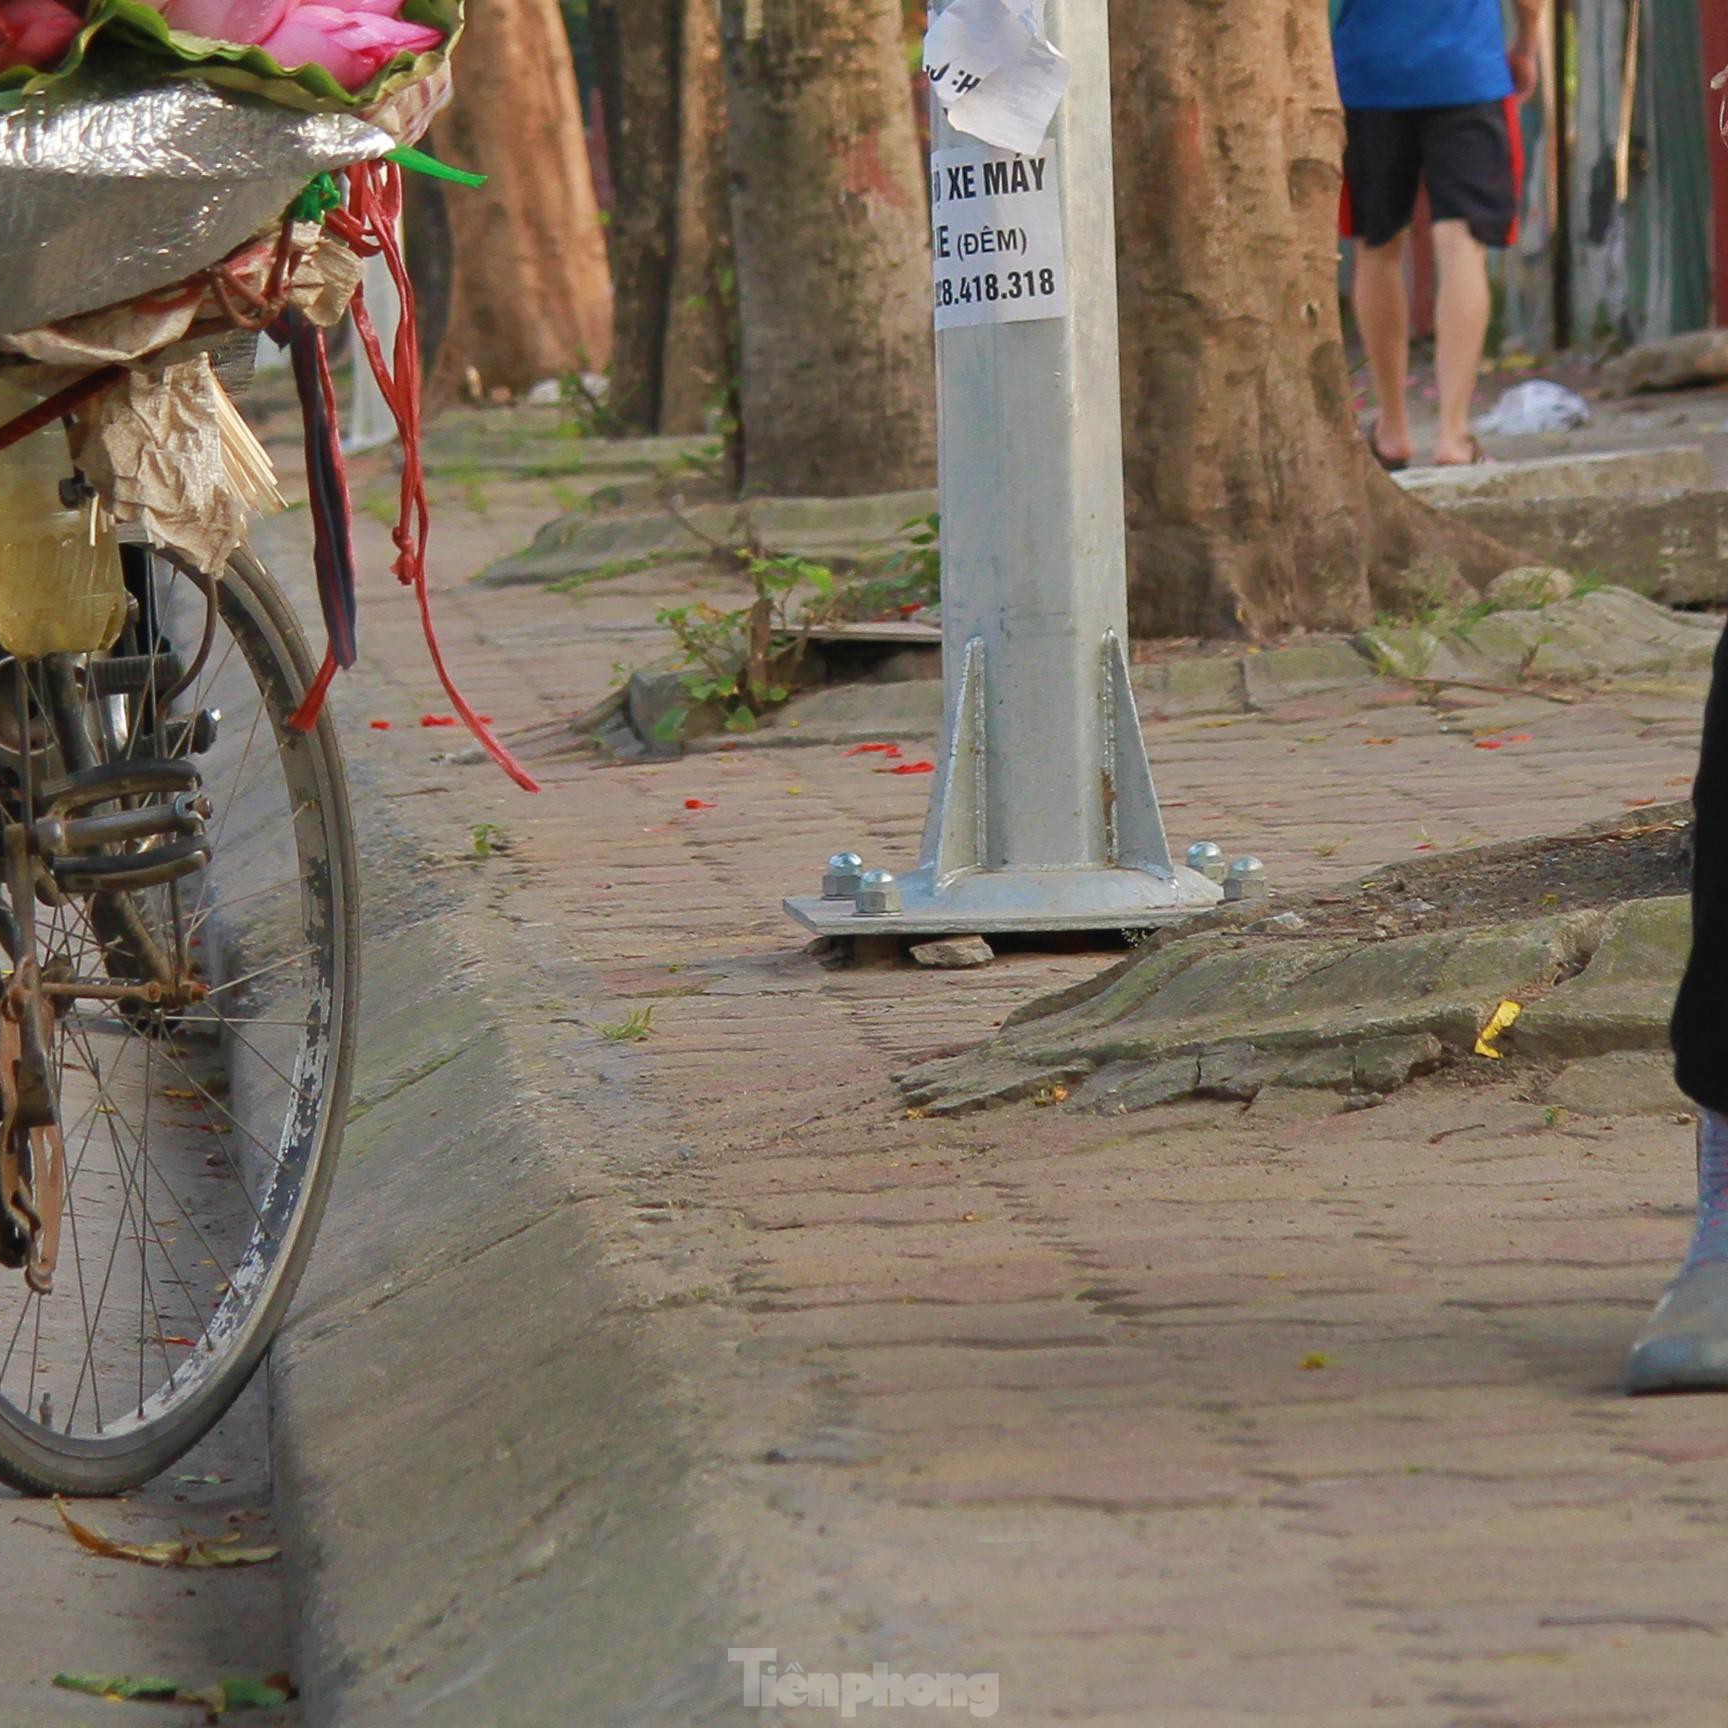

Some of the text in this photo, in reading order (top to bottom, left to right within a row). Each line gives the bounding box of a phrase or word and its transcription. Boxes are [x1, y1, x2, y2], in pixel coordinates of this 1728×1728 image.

[946, 165, 977, 201] XE
[982, 153, 1046, 197] MÁY
[957, 225, 1028, 261] (ĐÊM)
